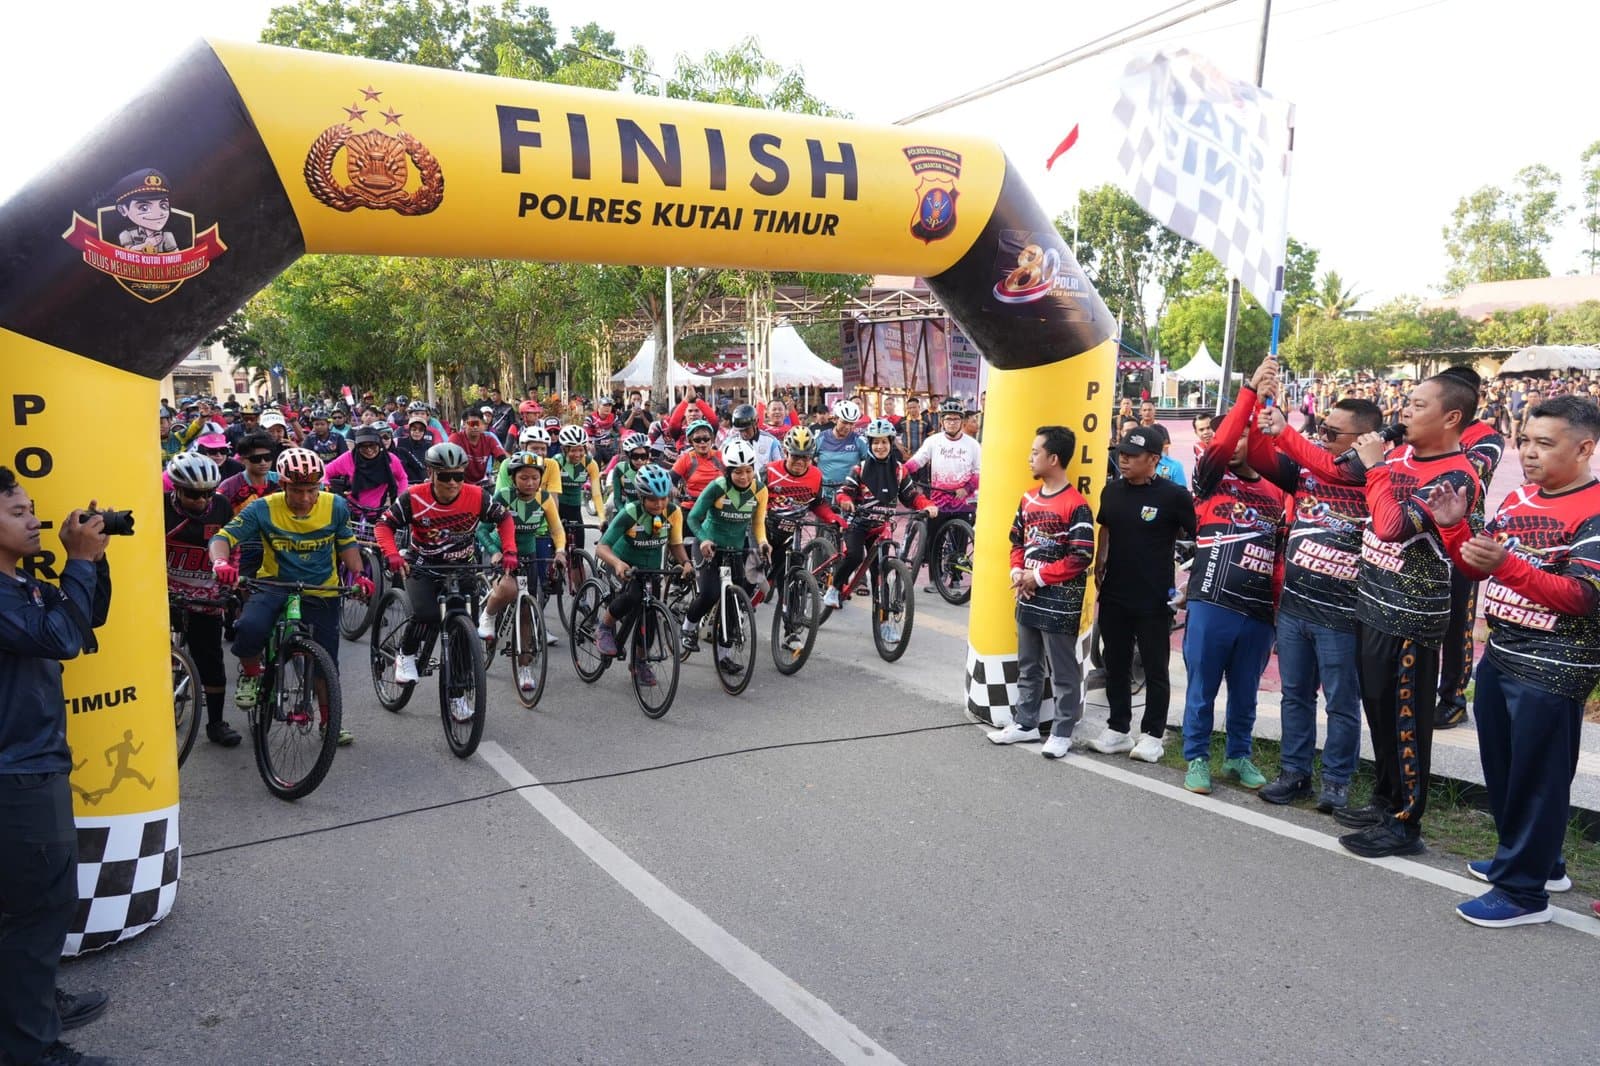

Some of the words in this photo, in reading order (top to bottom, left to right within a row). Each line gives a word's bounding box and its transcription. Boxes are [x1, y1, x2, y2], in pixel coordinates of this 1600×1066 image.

[495, 104, 859, 200] FINISH
[518, 192, 642, 225] POLRES
[652, 202, 743, 231] KUTAI
[753, 209, 839, 236] TIMUR
[87, 249, 109, 270] TULUS
[110, 260, 141, 277] MELAYANI
[144, 267, 165, 279] UNTUK
[167, 256, 206, 278] MASYARAKAT
[115, 249, 140, 263] POLRES
[141, 255, 161, 265] KUTAI
[162, 254, 182, 264] TIMUR
[1291, 550, 1360, 580] PRESISI
[1299, 538, 1358, 565] GOWES
[1201, 561, 1216, 593] POLRES
[1484, 598, 1558, 630] PRESISI
[65, 686, 138, 714] IMUR
